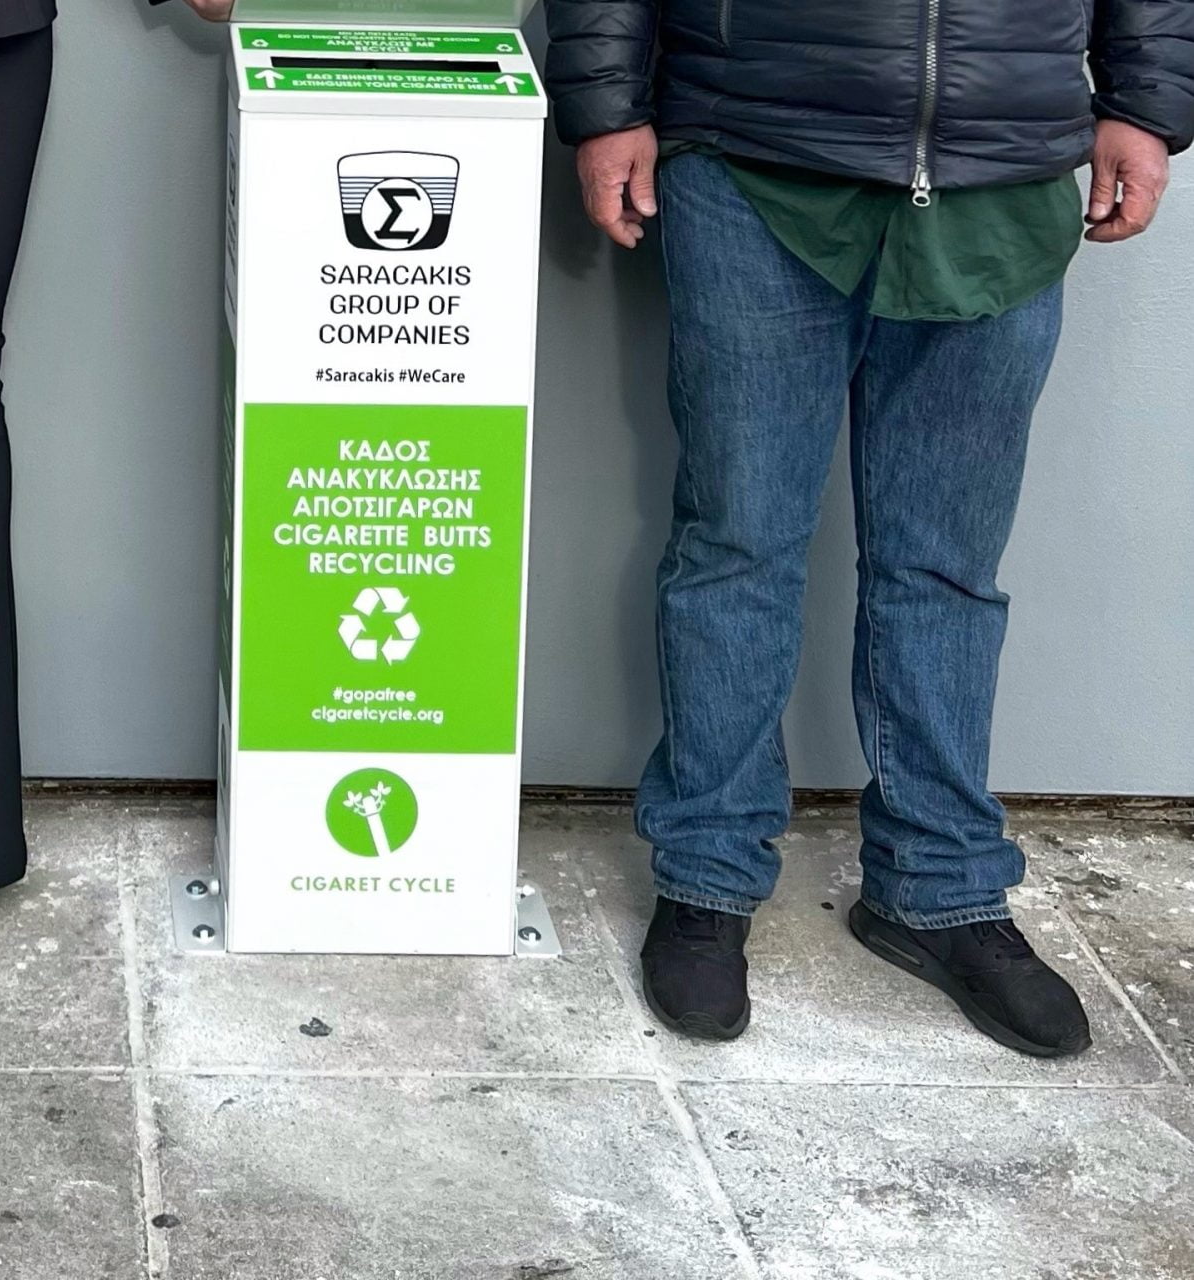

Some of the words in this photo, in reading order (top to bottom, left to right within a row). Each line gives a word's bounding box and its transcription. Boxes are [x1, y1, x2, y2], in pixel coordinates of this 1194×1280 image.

[291, 80, 362, 88] EXTINGUISH
[401, 82, 465, 90] CIGARETTE
[467, 83, 497, 91] HERE
[406, 75, 454, 83] ΤΣΙΓΑΡΟ
[456, 76, 480, 84] ΣΑΣ
[320, 264, 471, 286] SARACAKIS
[330, 294, 420, 315] GROUP
[428, 295, 461, 316] OF
[319, 324, 470, 345] COMPANIES
[316, 368, 395, 383] #Saracakis
[399, 369, 466, 384] #WeCare
[339, 439, 431, 462] ΚΑΔΟΣ
[286, 468, 482, 491] ΑΝΑΚΥΚΛΩΣΗΣ
[292, 496, 474, 519] ΑΠΟΤΣΙΓΑΡΩΝ
[273, 524, 409, 547] CIGARETTE
[423, 526, 492, 548] BUTTS
[308, 552, 456, 575] RECYCLING
[332, 687, 417, 704] #gopafree
[311, 705, 444, 724] cigaretcycle.org
[290, 876, 381, 892] CIGARET
[388, 877, 455, 893] CYCLE
